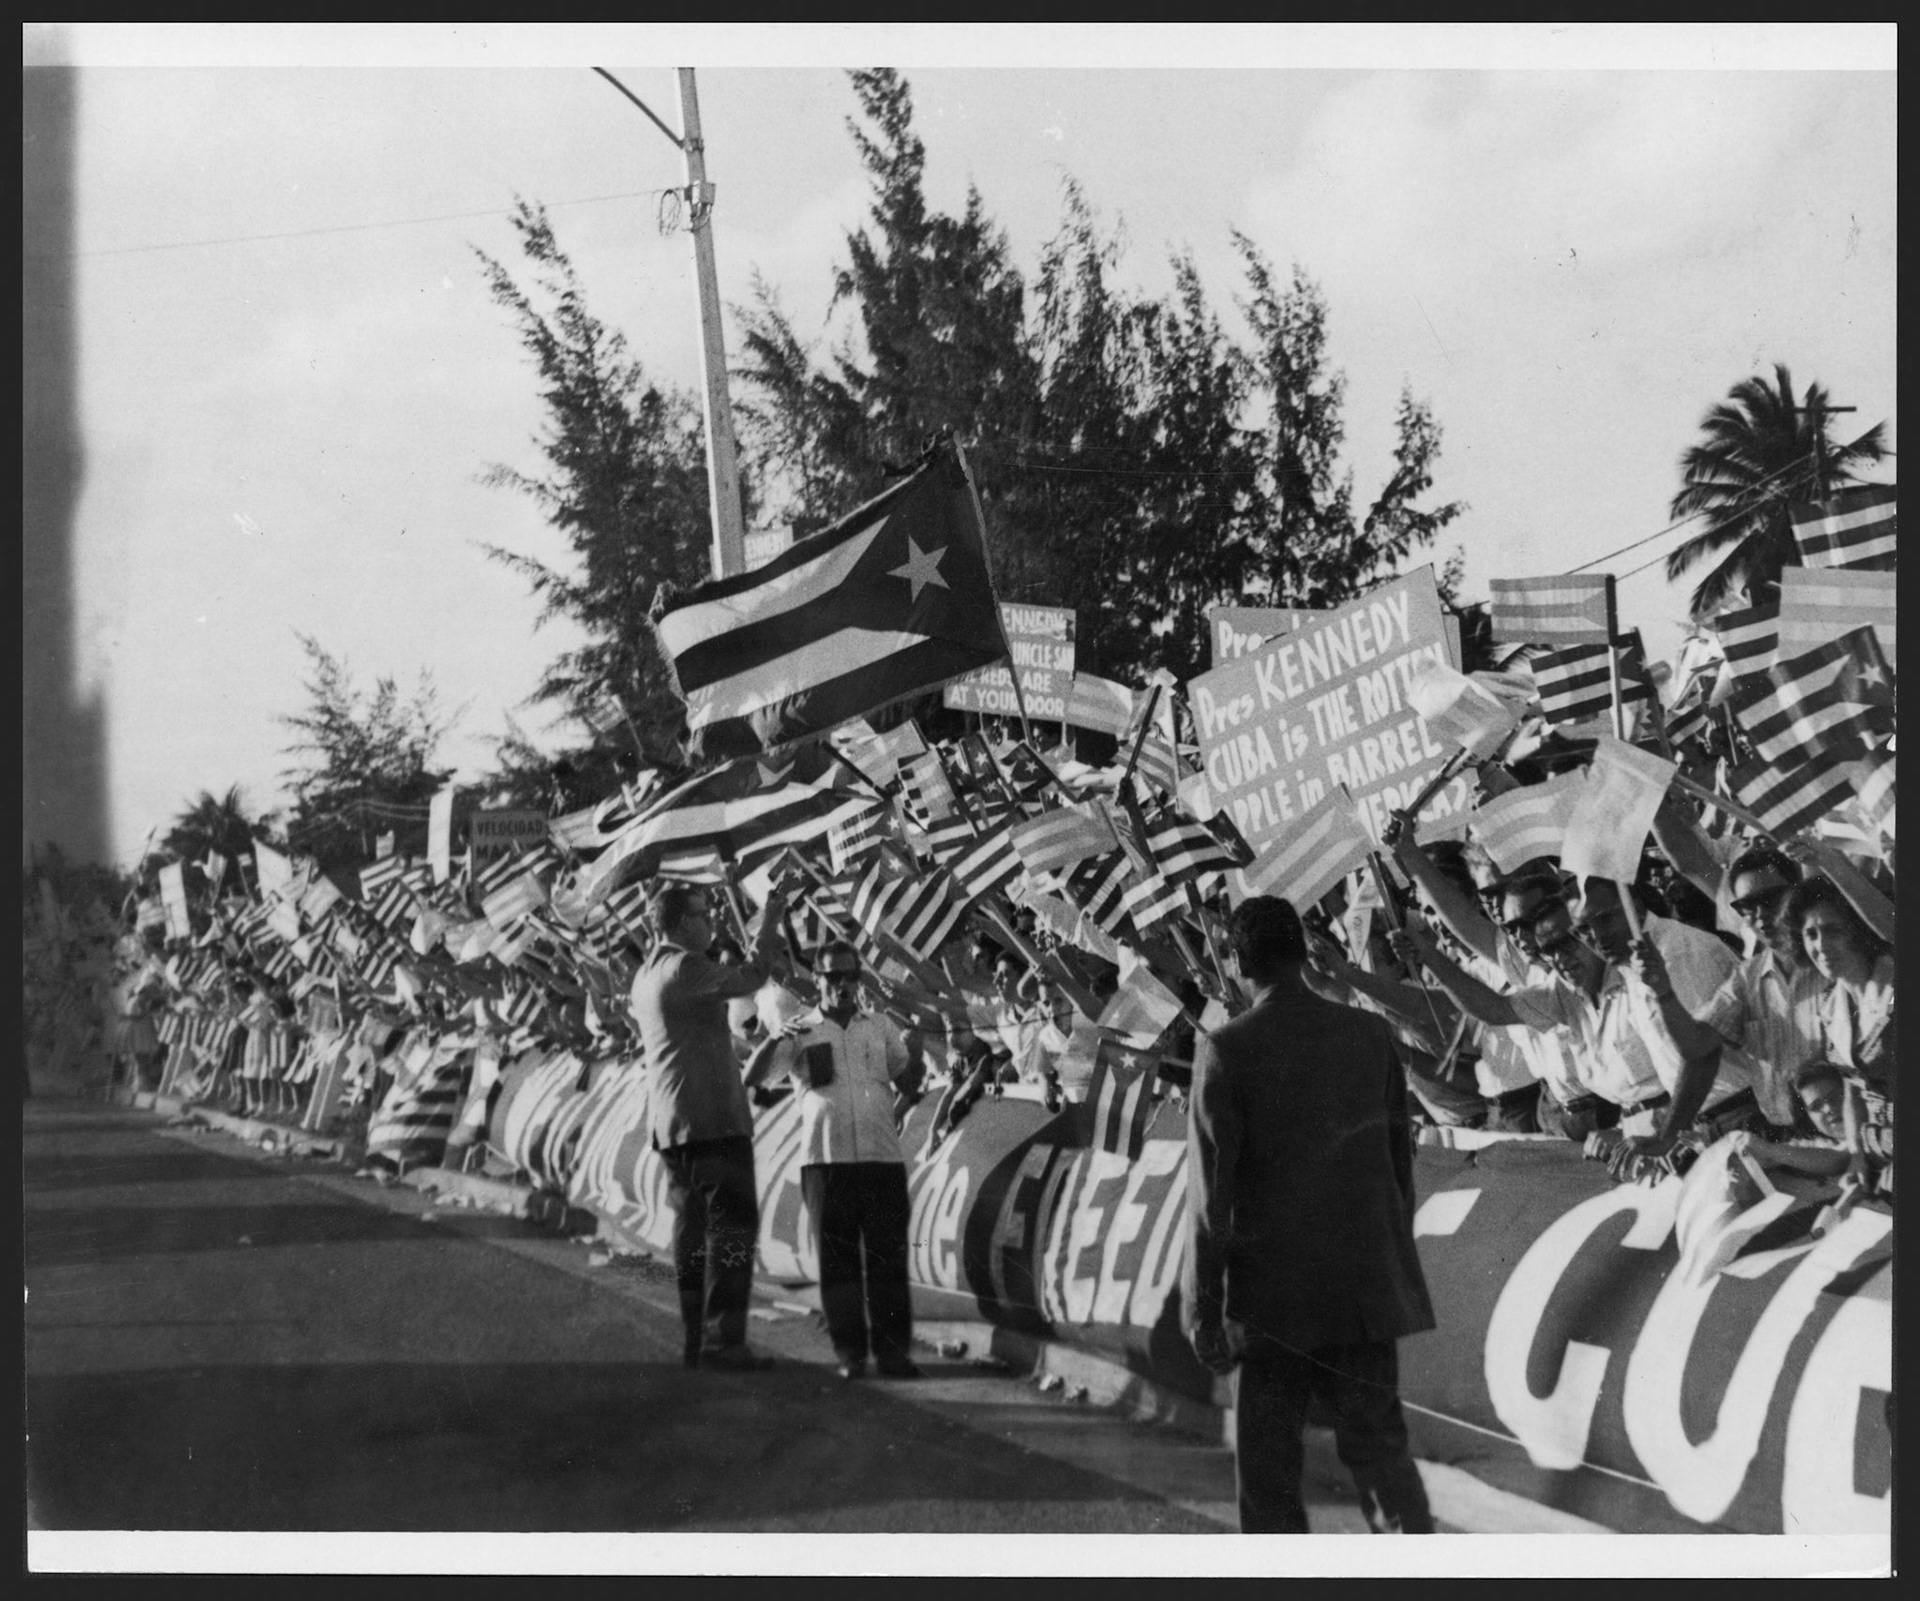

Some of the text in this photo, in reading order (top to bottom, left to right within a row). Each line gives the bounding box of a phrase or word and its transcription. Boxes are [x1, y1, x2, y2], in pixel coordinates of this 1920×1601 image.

[1001, 607, 1065, 634] ENNEDY
[1012, 641, 1052, 669] UNCLE
[1218, 620, 1274, 659] Pre
[1196, 590, 1410, 739] Pres KENNEDY
[1021, 671, 1052, 693] ARE
[949, 684, 1065, 717] AT YOUR DOOR
[1207, 726, 1278, 793] CUBA
[1279, 718, 1309, 762] is
[1306, 685, 1359, 746] THE
[1295, 769, 1325, 813] in
[1326, 716, 1443, 789] BARREL
[477, 819, 543, 836] VELOCIDAD
